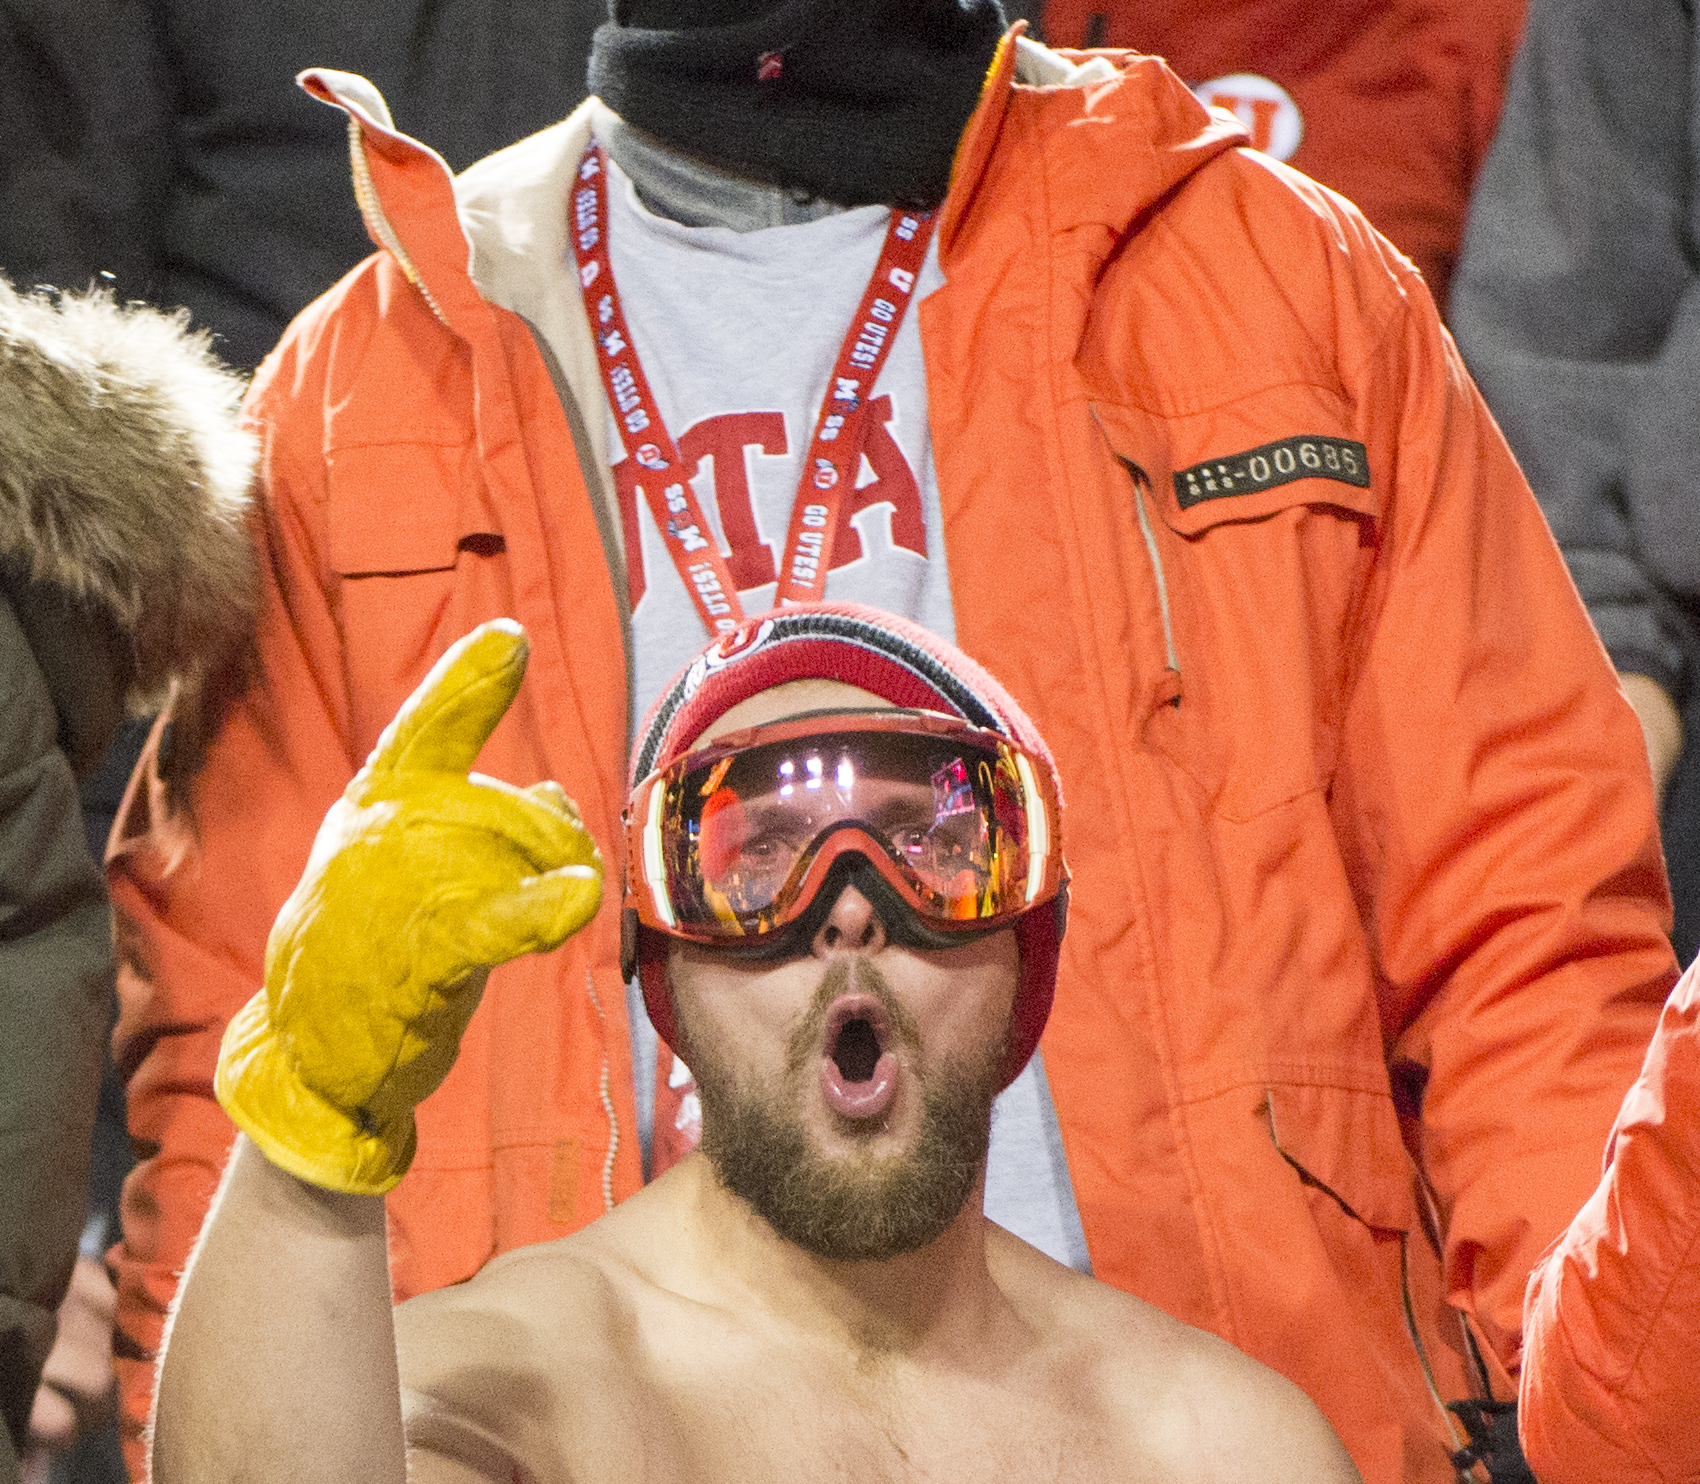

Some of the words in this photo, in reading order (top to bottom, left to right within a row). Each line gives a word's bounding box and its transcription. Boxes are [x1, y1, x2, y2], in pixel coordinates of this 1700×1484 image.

[888, 266, 915, 294] U
[870, 297, 897, 322] GO
[849, 321, 888, 370] UTES!
[802, 504, 828, 528] GO
[790, 532, 824, 589] UTES!
[688, 562, 731, 616] UTES!
